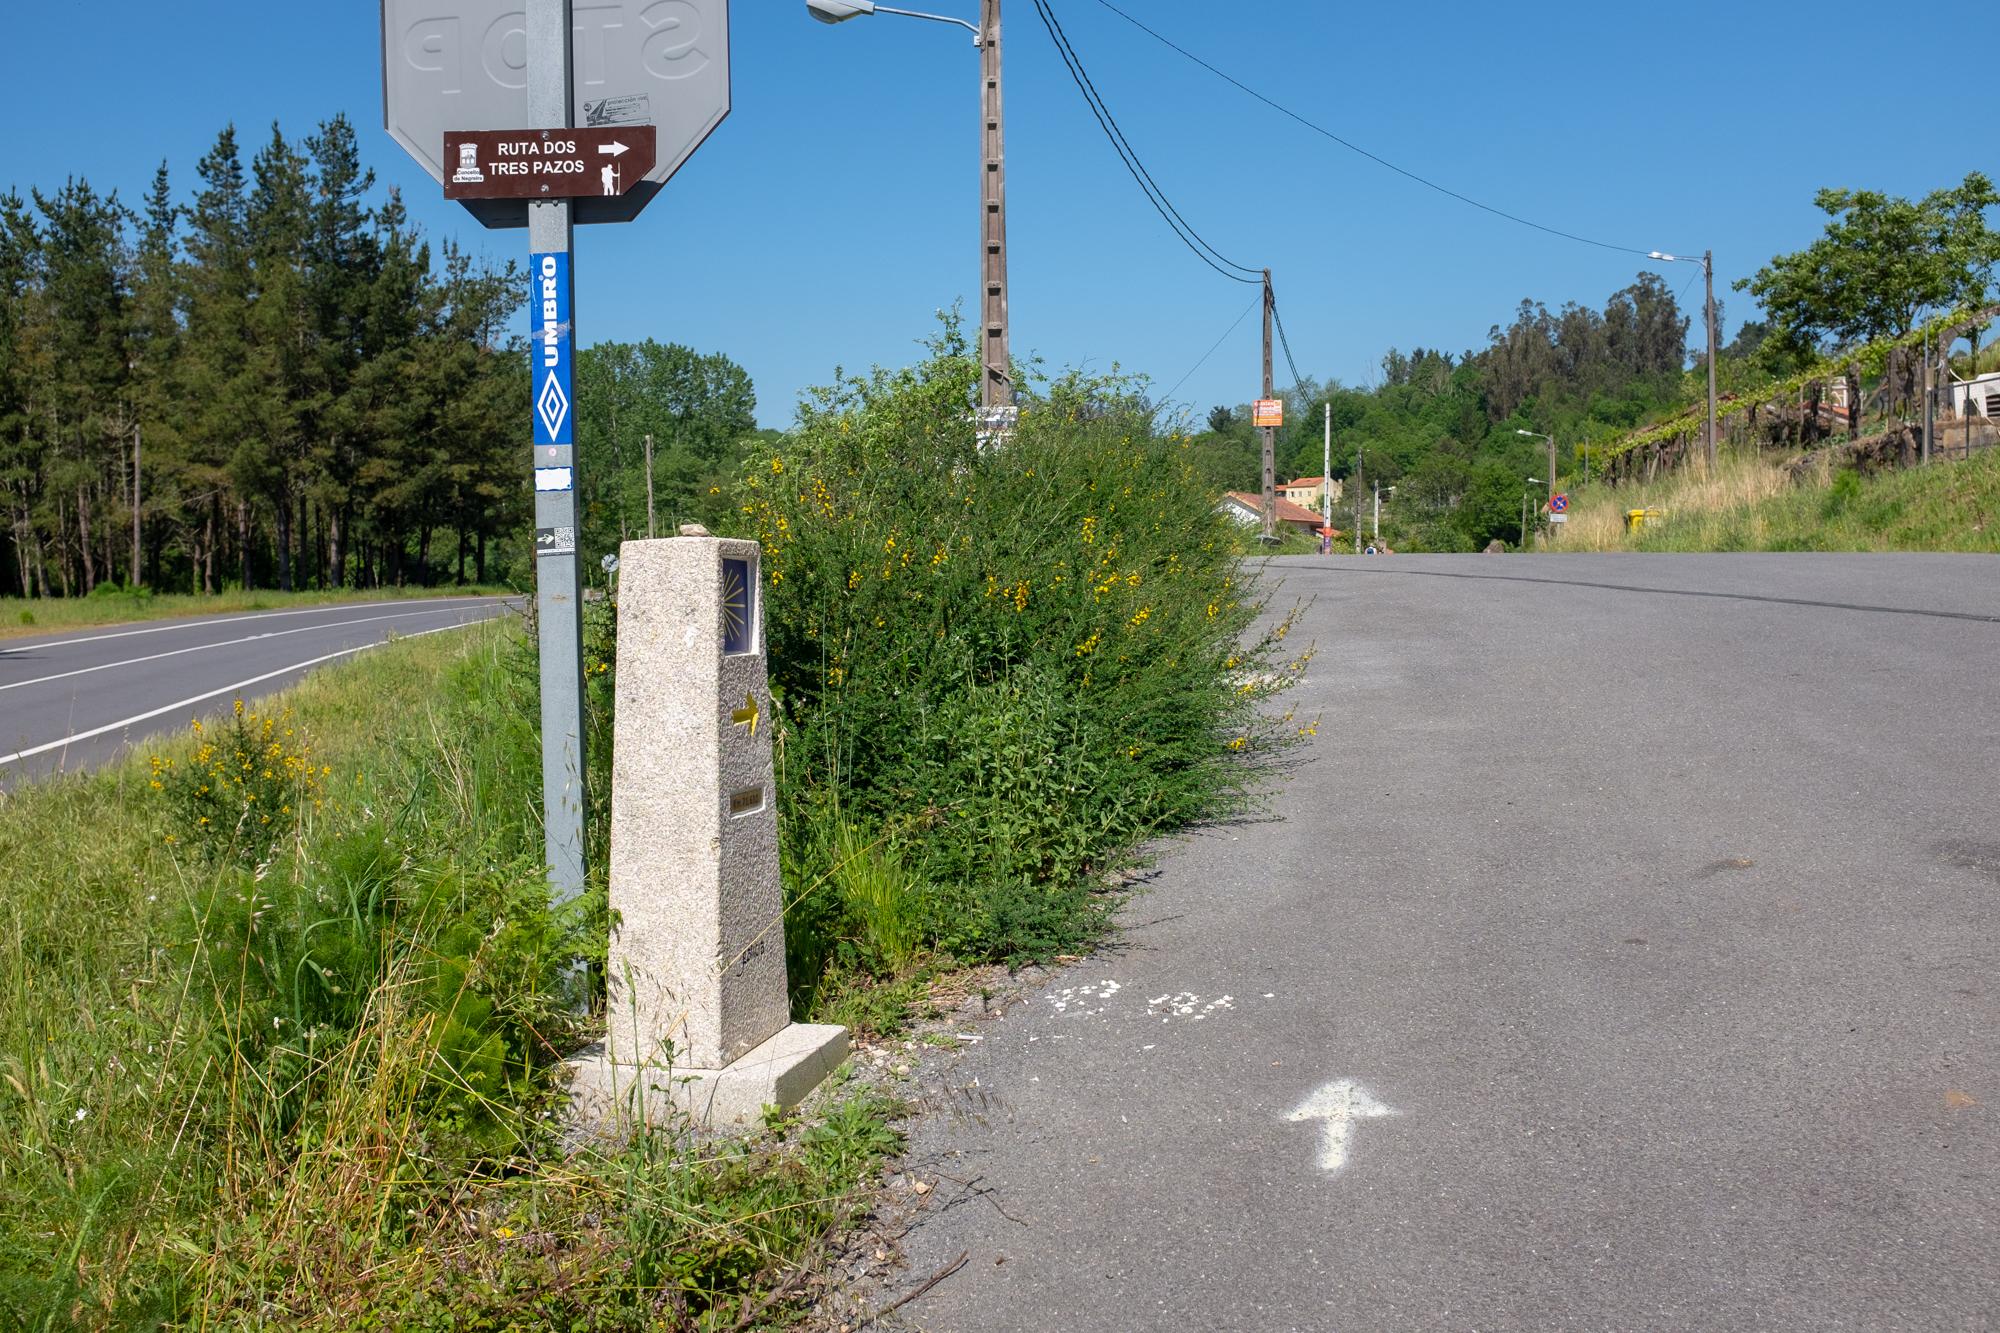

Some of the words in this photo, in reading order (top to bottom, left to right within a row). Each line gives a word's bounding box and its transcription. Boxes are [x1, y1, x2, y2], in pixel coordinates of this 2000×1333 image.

[498, 142, 540, 155] RUTA
[544, 141, 576, 154] DOS
[489, 162, 529, 175] TRES
[533, 160, 585, 174] PAZOS
[542, 256, 558, 367] UMBRO
